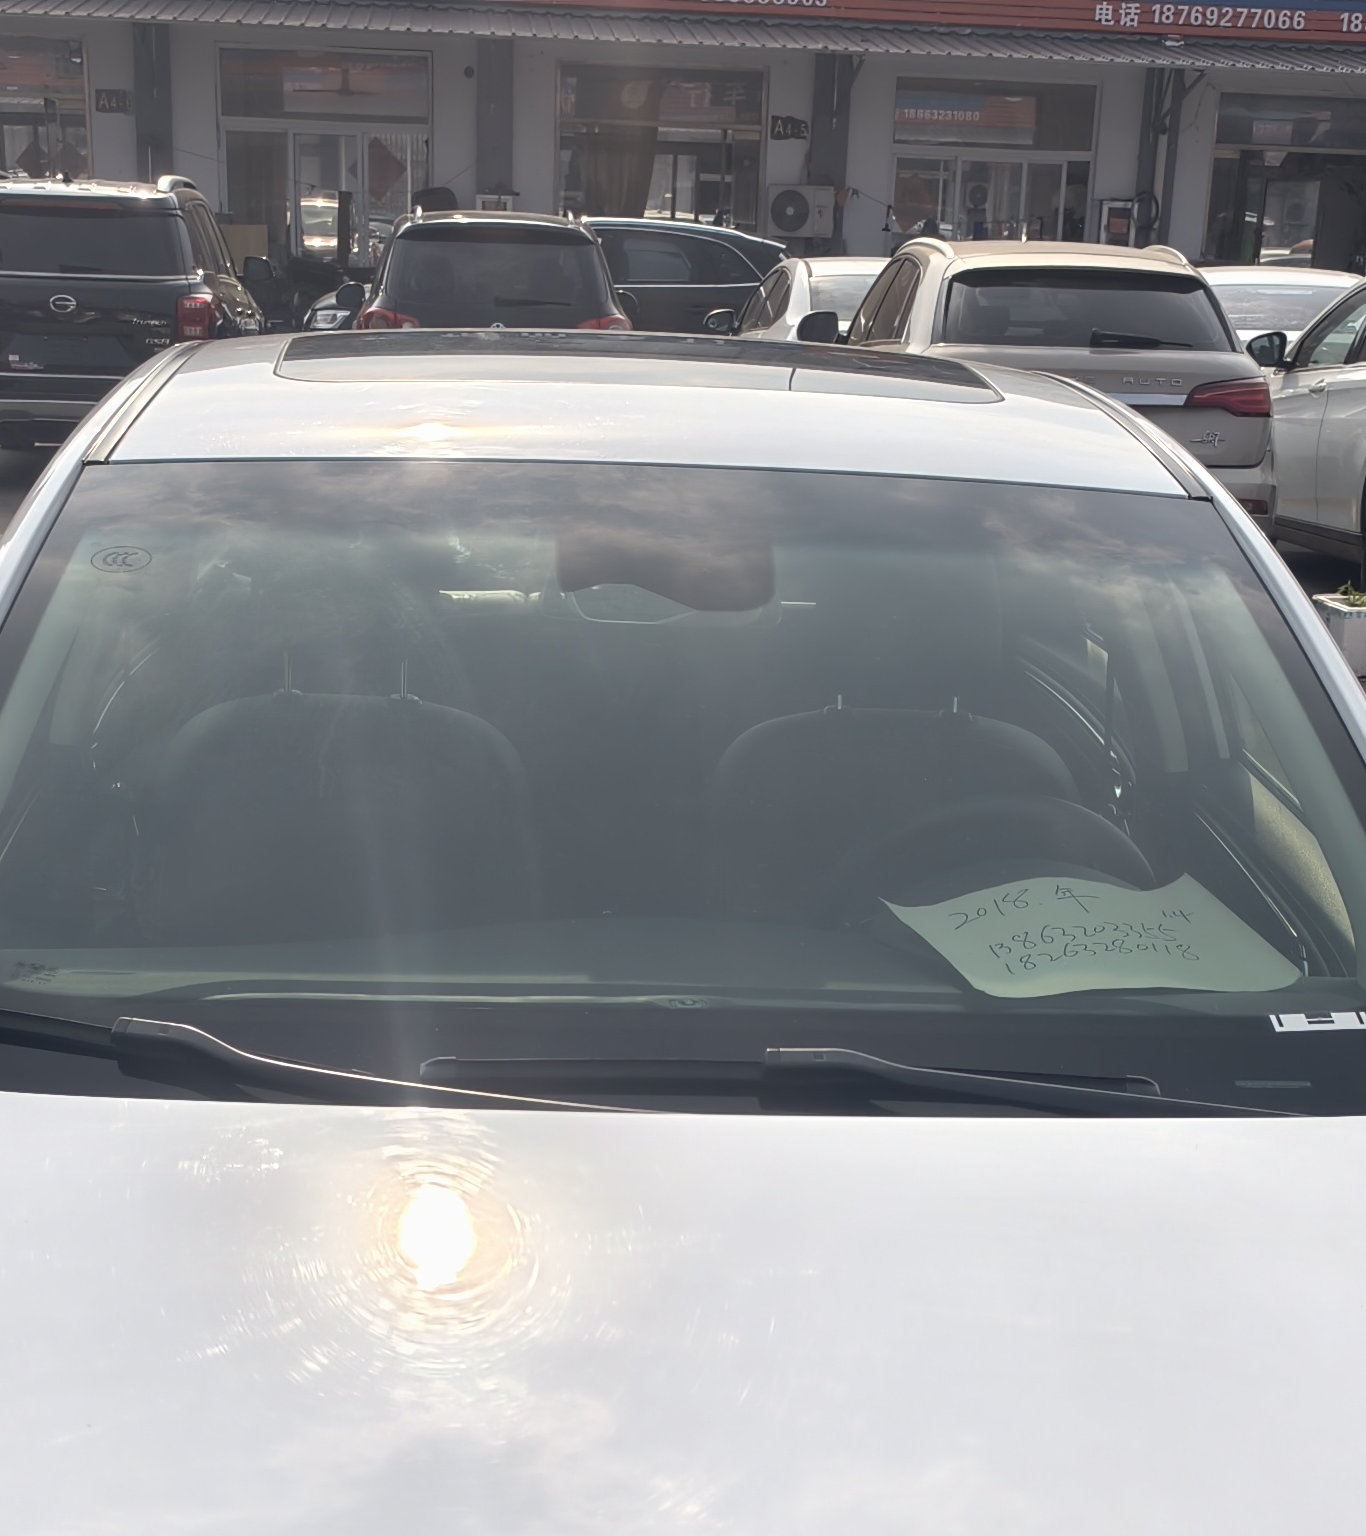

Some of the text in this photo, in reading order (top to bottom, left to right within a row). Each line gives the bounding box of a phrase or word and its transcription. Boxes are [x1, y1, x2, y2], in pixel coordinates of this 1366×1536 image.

[1094, 2, 1140, 28] 电话
[1151, 4, 1306, 30] 18769277066
[1122, 376, 1183, 387] AUTO
